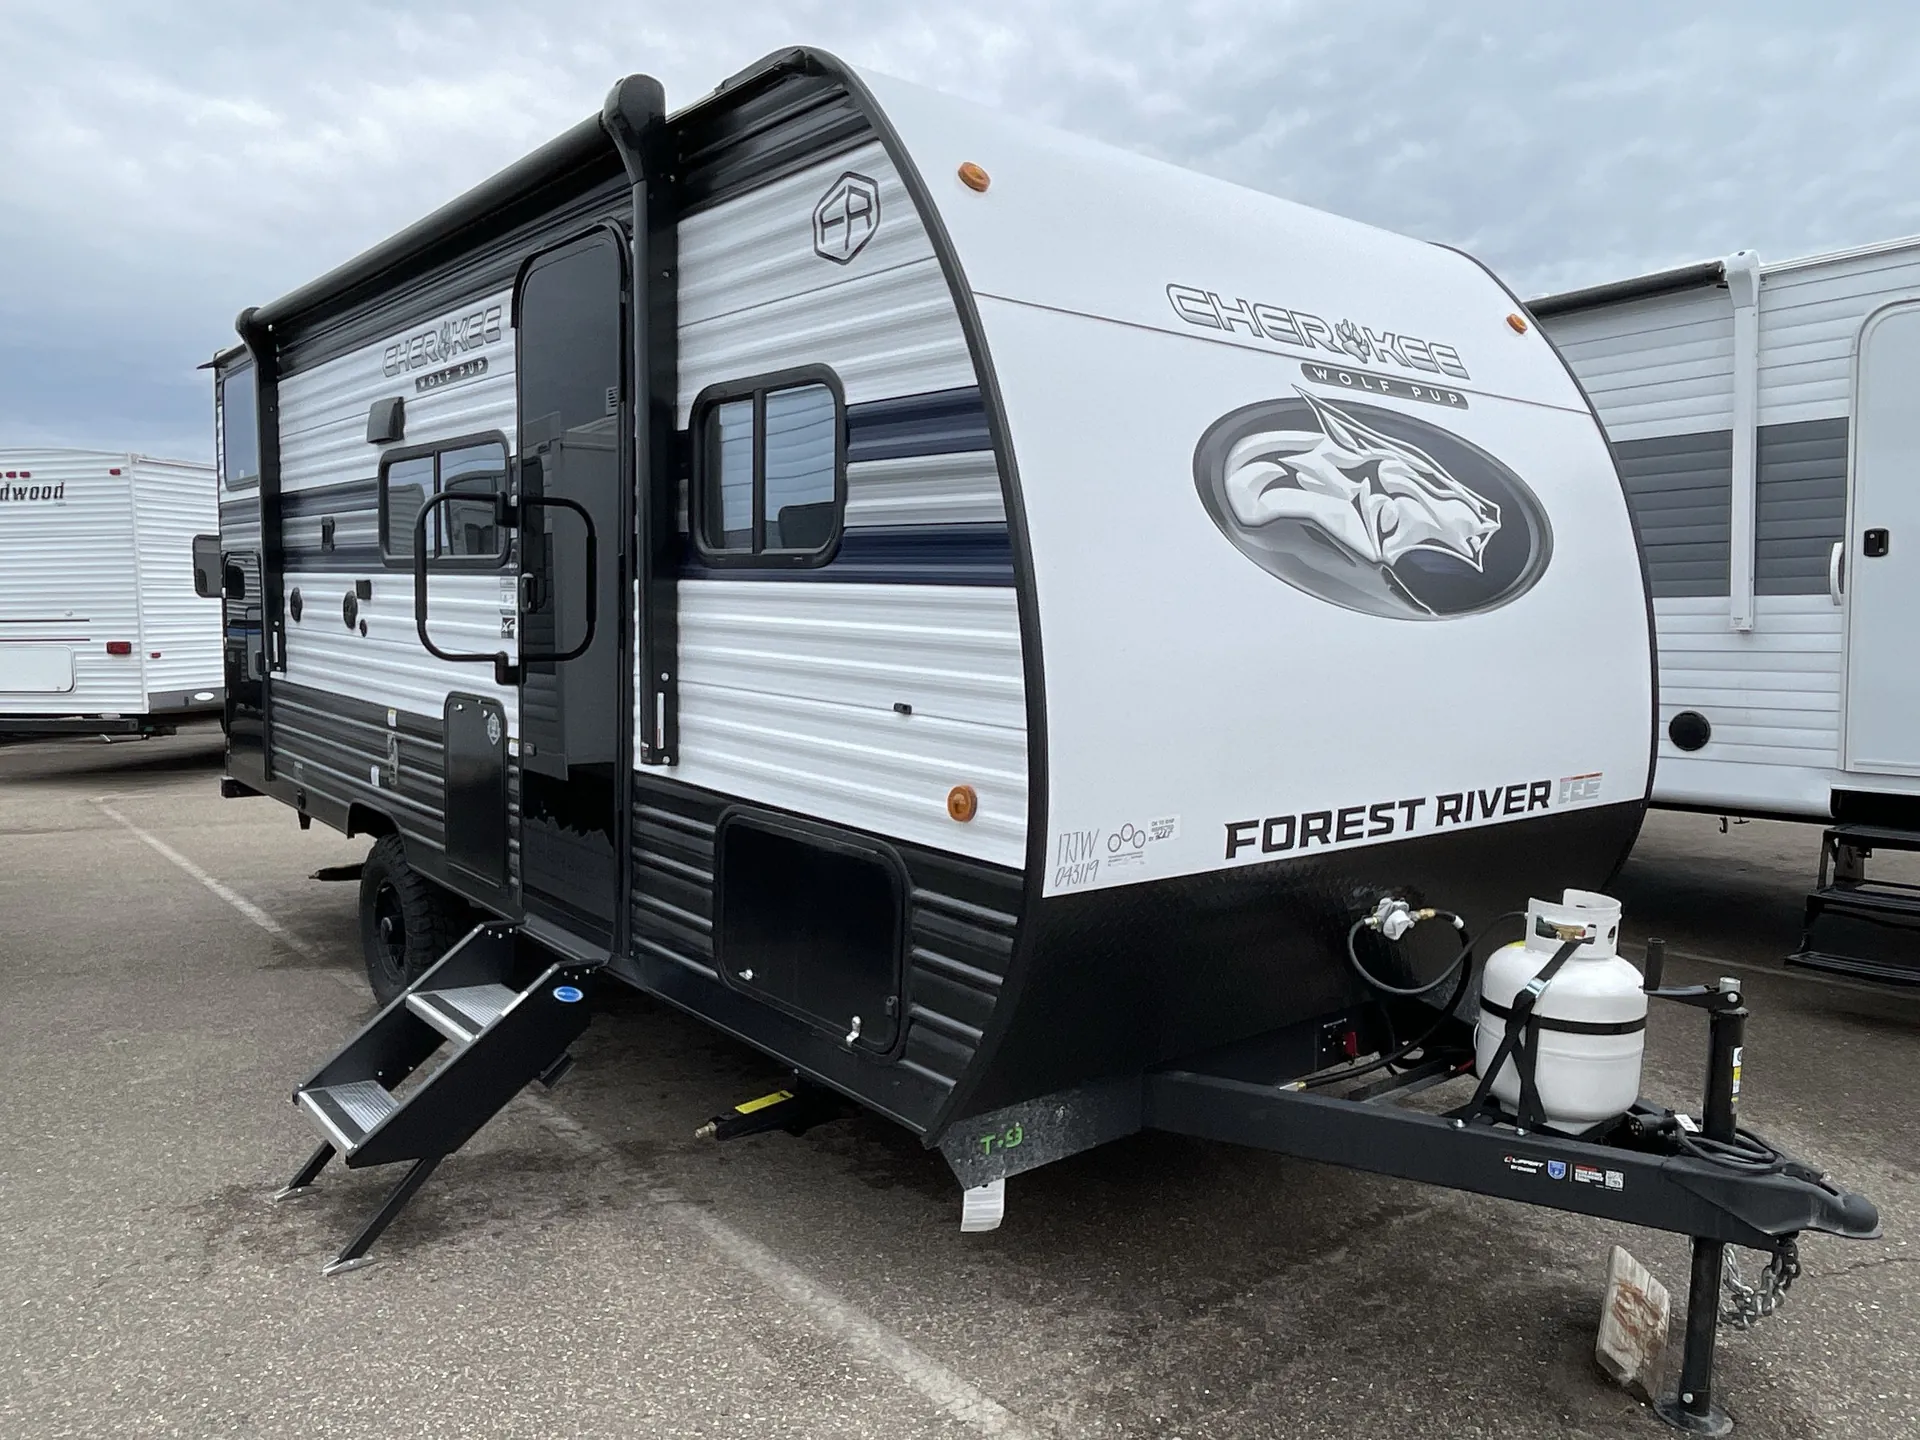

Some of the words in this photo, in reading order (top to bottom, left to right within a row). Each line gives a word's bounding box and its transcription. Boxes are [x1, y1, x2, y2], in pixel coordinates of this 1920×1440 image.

[420, 371, 451, 389] WOLF
[460, 360, 485, 377] PUP
[1312, 366, 1390, 392] WOLF
[1411, 386, 1459, 405] PUP
[1224, 797, 1426, 859] FOREST
[1435, 779, 1552, 827] RIVER
